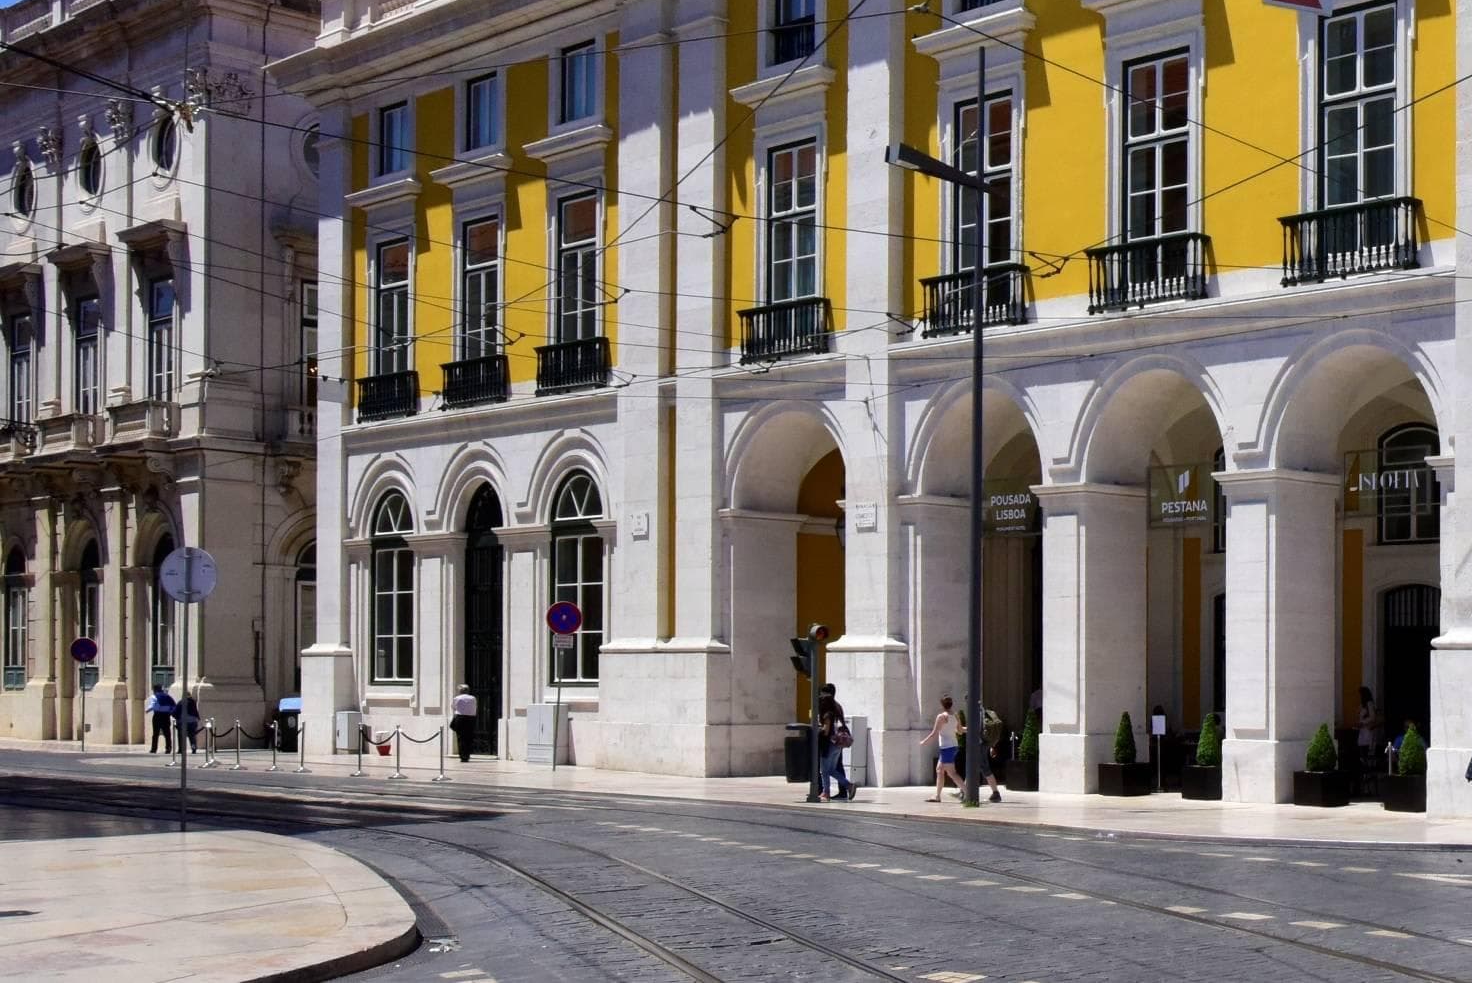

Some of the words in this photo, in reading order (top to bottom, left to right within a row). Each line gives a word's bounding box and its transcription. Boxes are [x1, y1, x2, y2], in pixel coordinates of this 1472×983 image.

[991, 494, 1031, 506] POUSADA
[1161, 500, 1208, 513] PESTANA
[996, 509, 1026, 520] LISBOA
